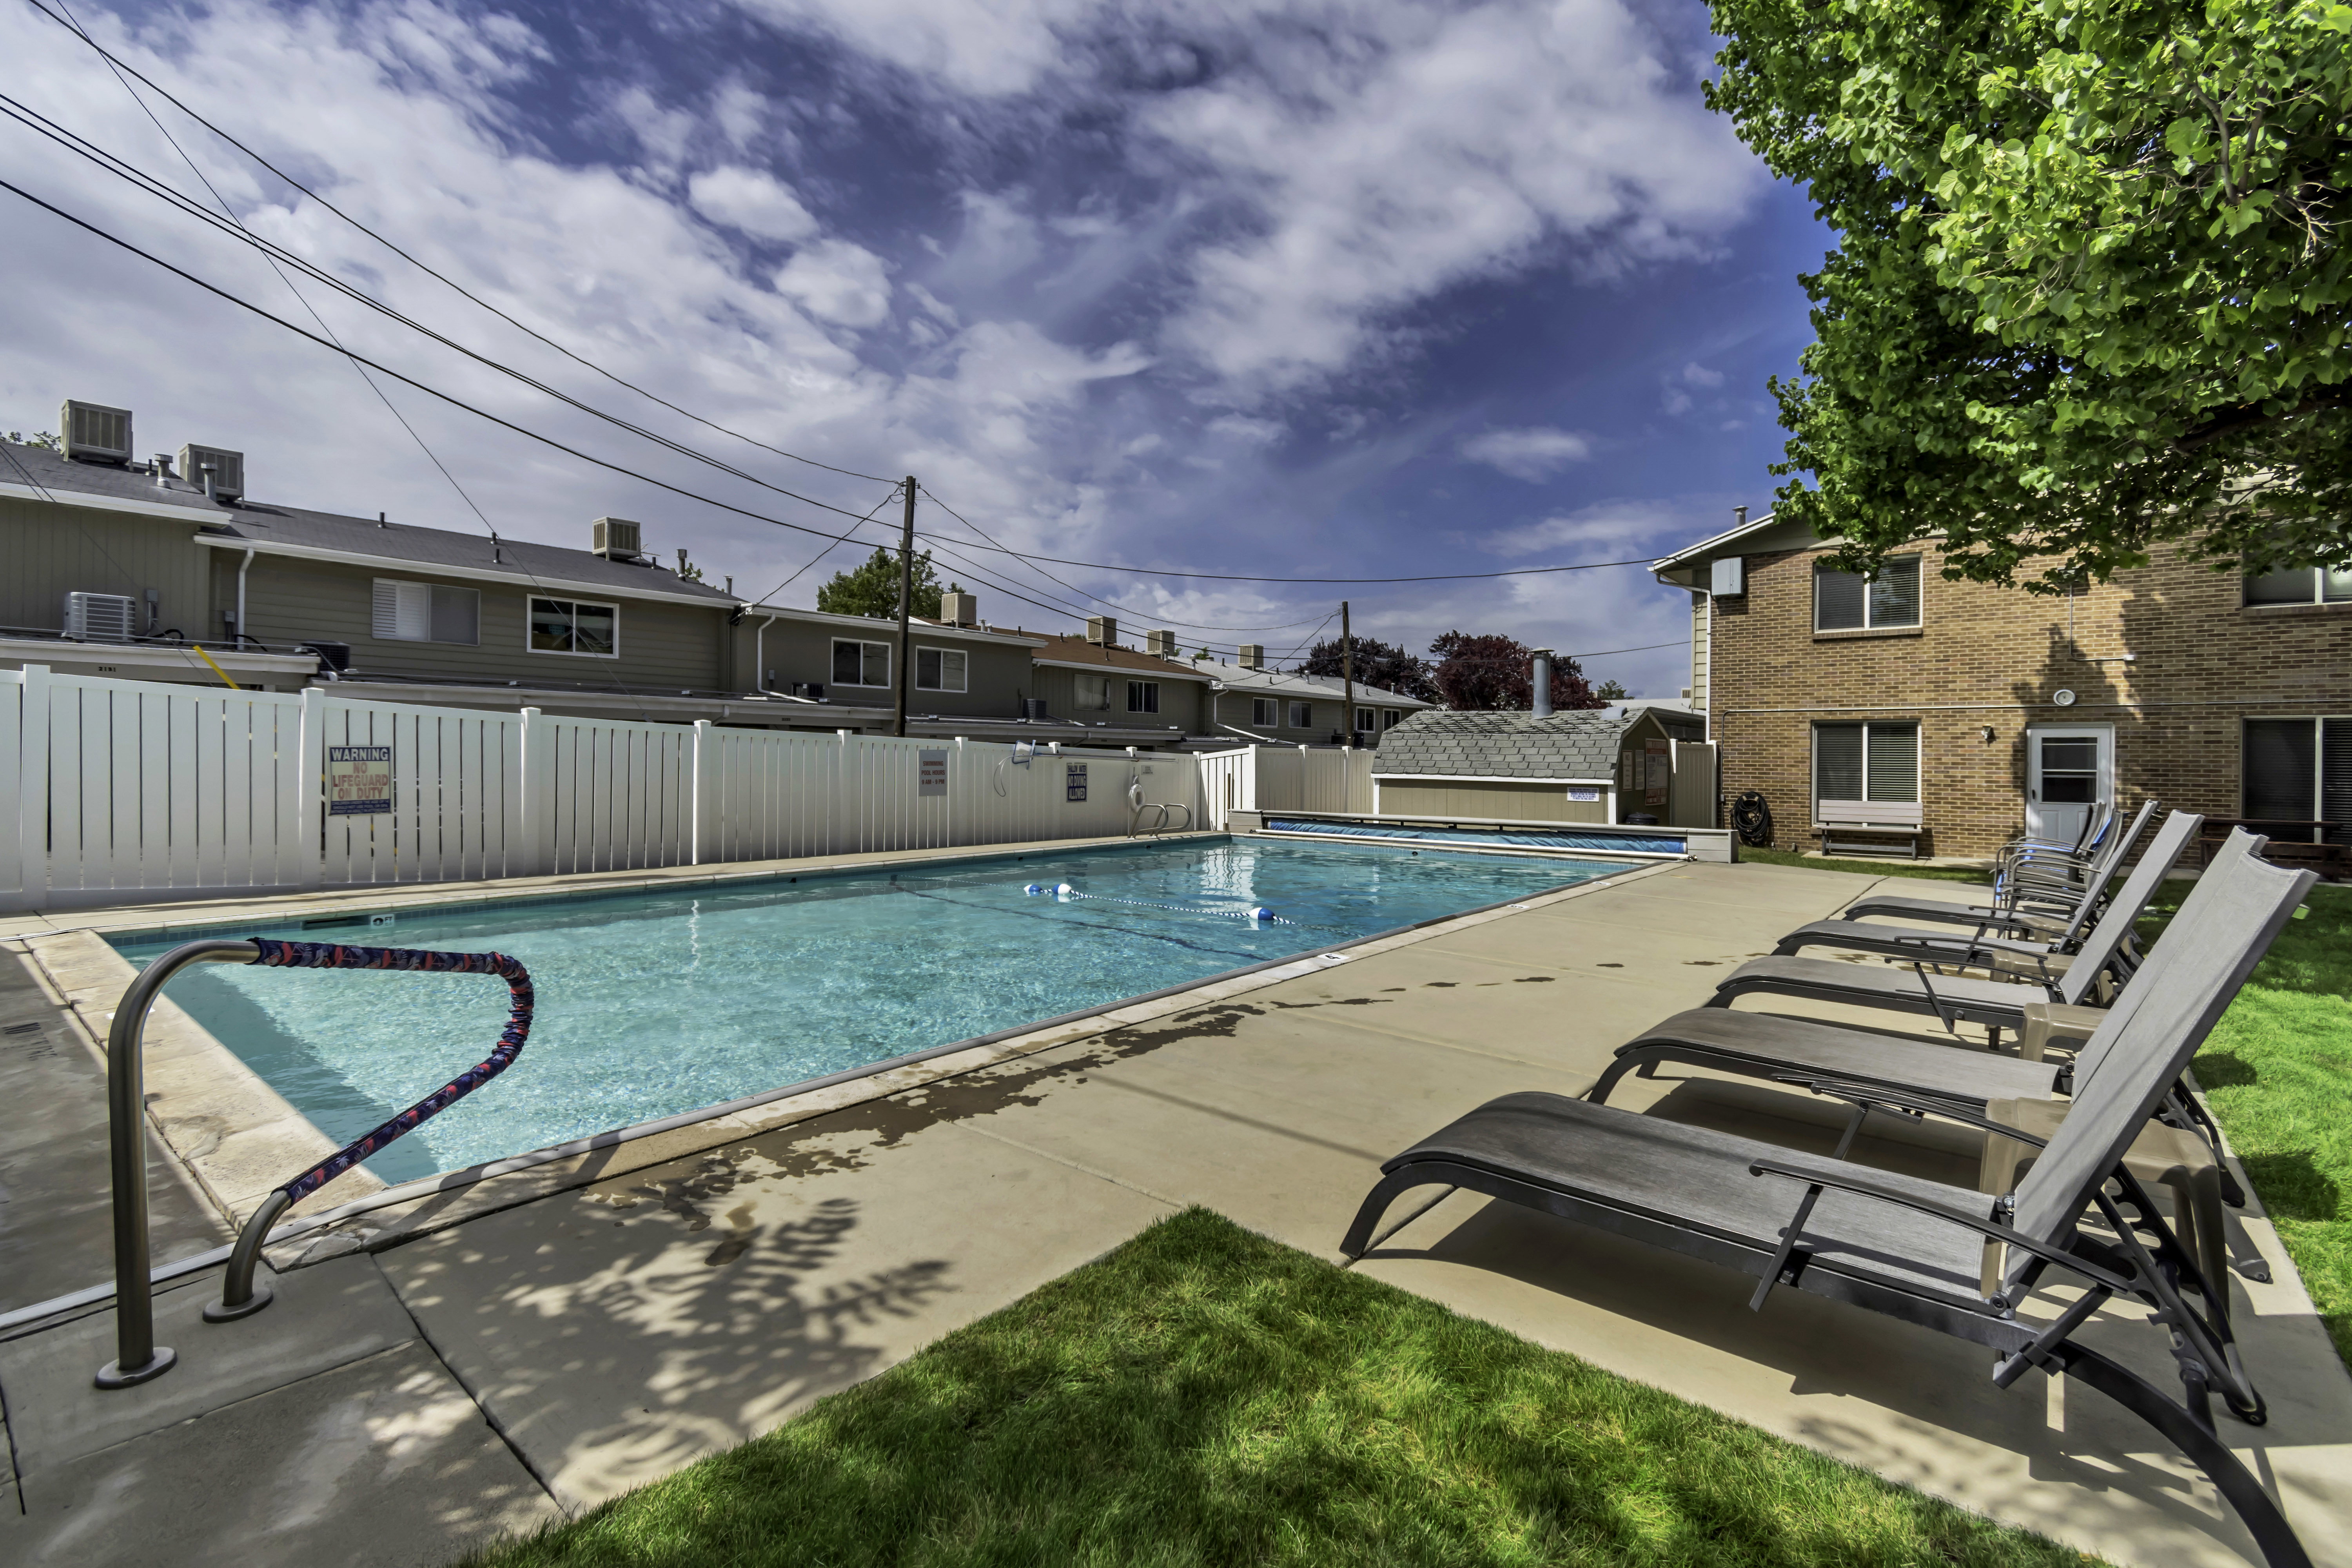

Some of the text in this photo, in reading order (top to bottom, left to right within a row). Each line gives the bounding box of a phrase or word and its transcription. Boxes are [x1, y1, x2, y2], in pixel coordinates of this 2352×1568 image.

[332, 748, 388, 760] WARNING
[353, 762, 367, 774] NO
[333, 774, 388, 787] LIFEGUARD
[1068, 775, 1086, 787] NO DIVING
[338, 787, 383, 800] ON DUTY
[1069, 788, 1085, 799] ALLOWED
